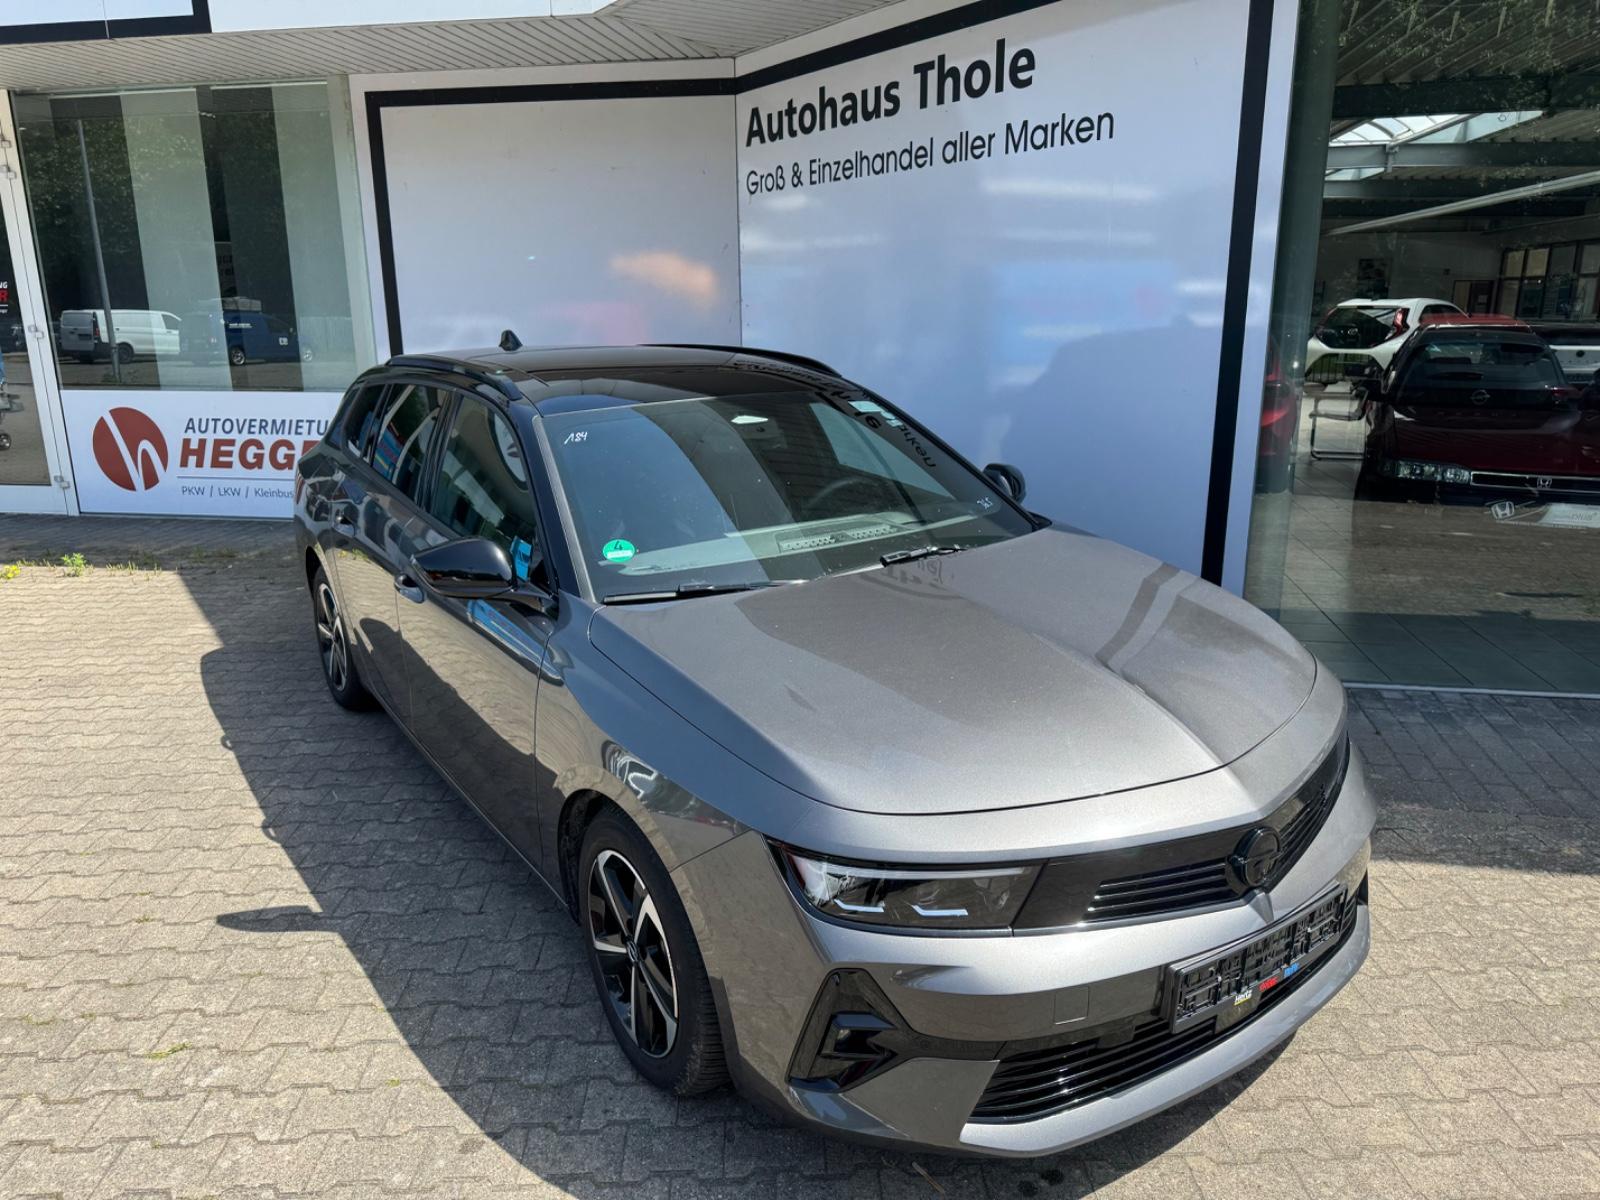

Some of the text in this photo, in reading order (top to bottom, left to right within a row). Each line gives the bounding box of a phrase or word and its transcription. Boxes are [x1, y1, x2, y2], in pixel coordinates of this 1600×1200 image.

[745, 38, 1036, 147] Autohaus Thole
[746, 111, 1114, 196] Groß & Einzelhandel aller Marken
[184, 418, 328, 436] AUTOVERMIETU
[182, 486, 205, 497] PKW
[218, 487, 241, 498] LKW
[613, 540, 624, 550] 4
